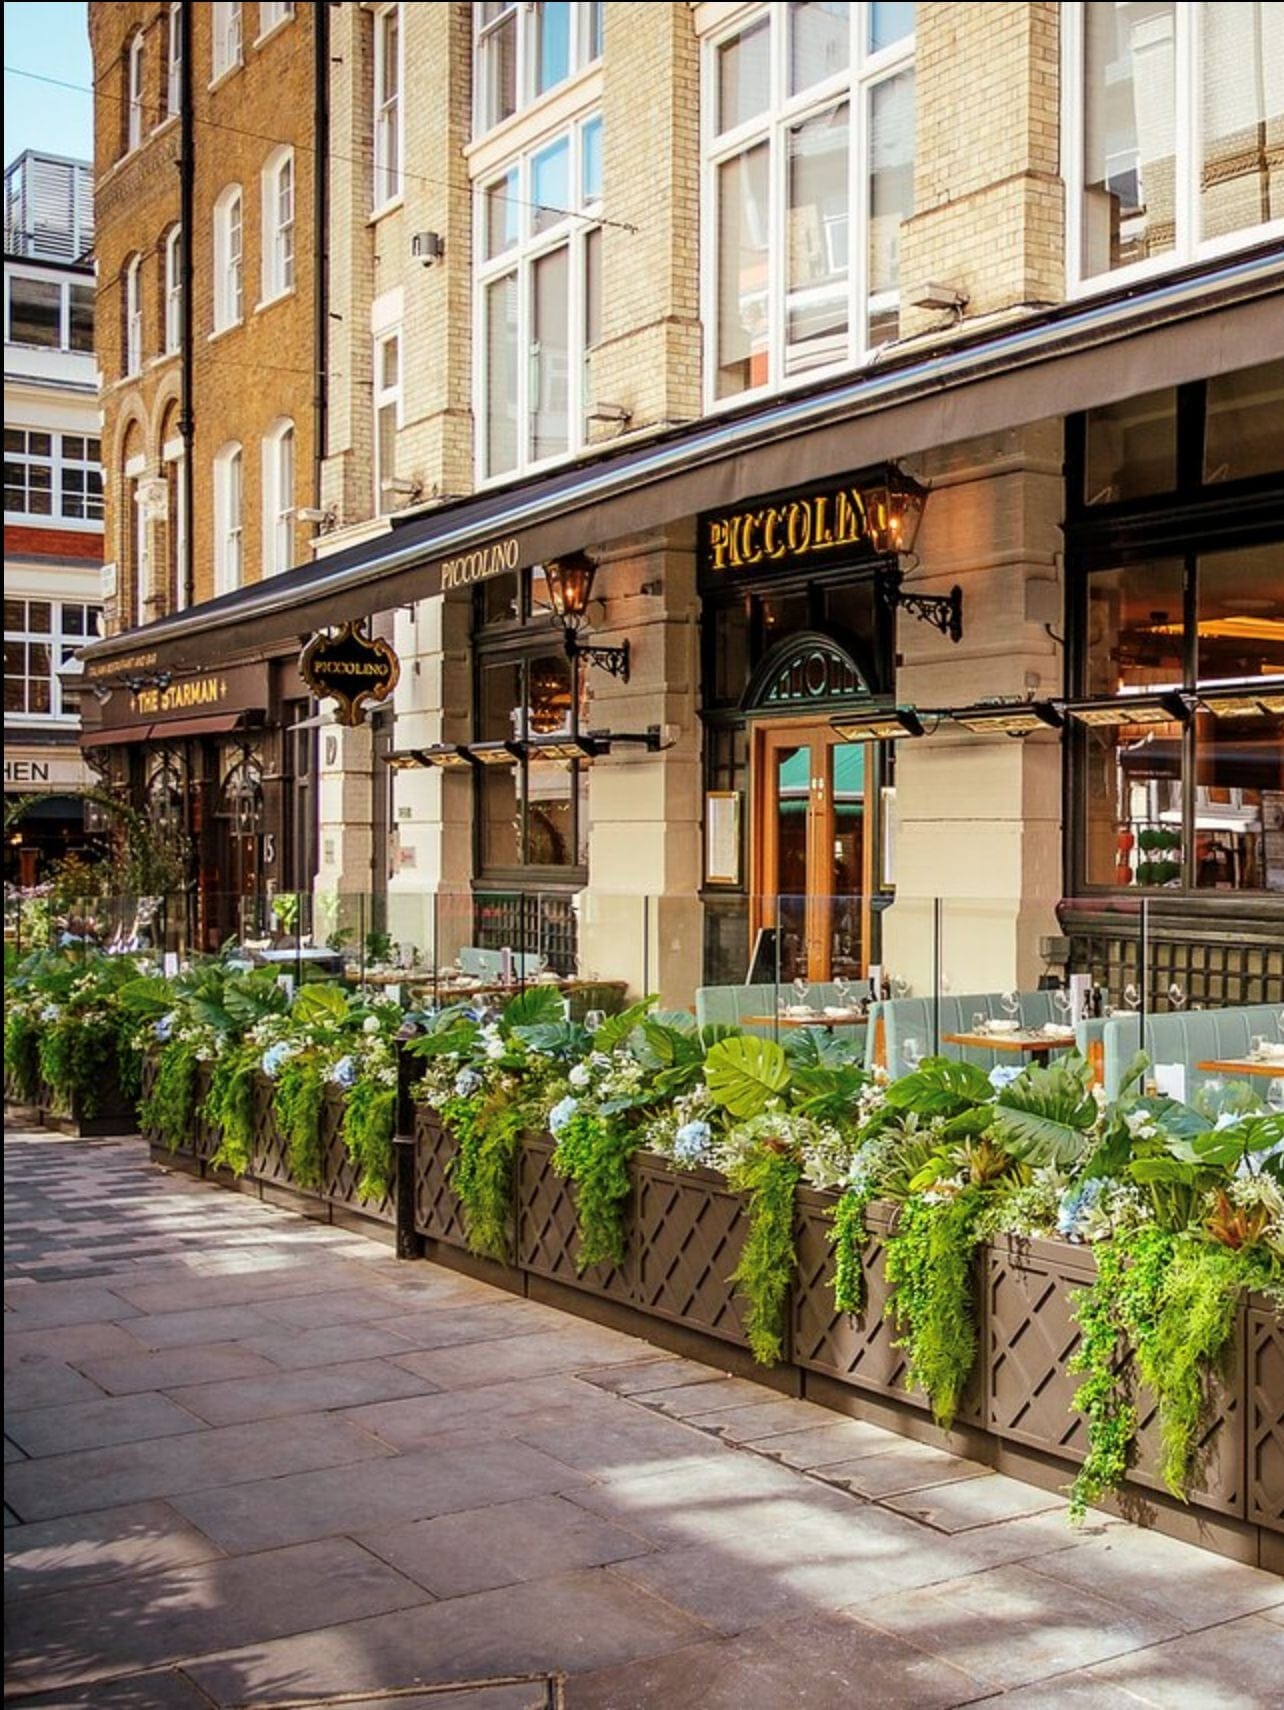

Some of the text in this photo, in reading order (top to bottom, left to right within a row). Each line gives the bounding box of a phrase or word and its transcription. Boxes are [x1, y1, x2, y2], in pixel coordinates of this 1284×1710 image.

[440, 538, 519, 590] PICCOLINO
[314, 661, 389, 677] PICCOLINO
[138, 678, 218, 714] THE STARMAN
